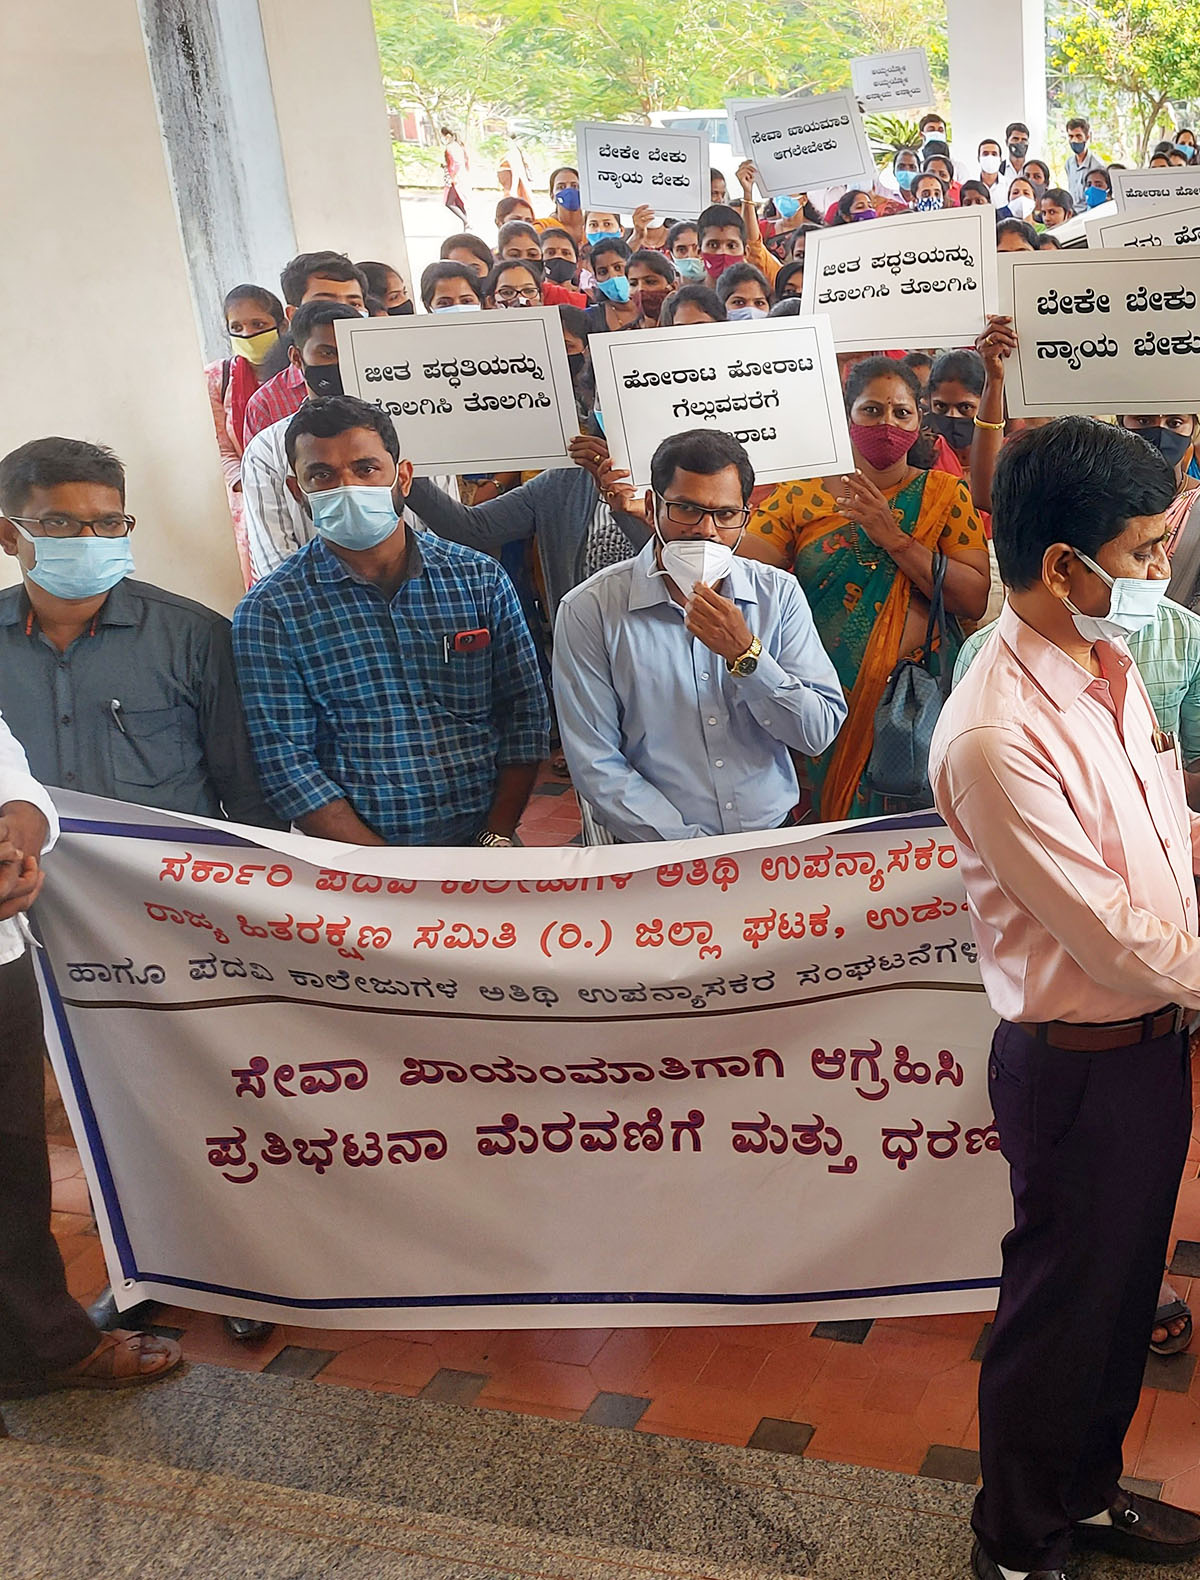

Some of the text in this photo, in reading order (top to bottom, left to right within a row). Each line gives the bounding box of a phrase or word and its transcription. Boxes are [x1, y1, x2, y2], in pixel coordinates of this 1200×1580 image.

[599, 143, 687, 163] ಬೇಕೇ ಬೇಕು
[751, 129, 782, 145] ಸೇವಾ
[598, 169, 691, 189] ನ್ಯಾಯ ಬೇಕು
[1125, 188, 1171, 198] ಹೋರಾಟ
[823, 244, 975, 277] ಜೀತ ಪದ್ಧತಿಯನ್ನು
[818, 276, 978, 304] ತೊಲಗಿಸಿ ತೊಲಗಿಸಿ
[1036, 284, 1197, 315] ಬೇಕೇ ಬೇಕು
[1036, 333, 1119, 370] ನ್ಯಾಯ
[364, 352, 545, 389] ಜೀತ ಪದ್ಧತಿಯನ್ನು
[623, 357, 814, 389] ಹೋರಾಟ ಹೋರಾಟ
[463, 391, 551, 412] ತೊಲಗಿಸಿ
[672, 389, 780, 421] ಗೆಲ್ಲುವವರೆಗೆ
[727, 425, 777, 444] ರಾಟ
[158, 852, 294, 888] ಸರ್ಕಾರಿ
[655, 857, 740, 893] ಅತಿಥಿ
[761, 838, 959, 893] ಉಪನ್ಯಾಸಕರ
[143, 901, 231, 945] ರಾಜ್ಯ
[412, 917, 518, 950] ಸಮಿತಿ
[539, 919, 614, 958] (ರಿ.)
[634, 917, 723, 960] ಜಿಲ್ಲಾ
[742, 904, 846, 949] ಘಟಕ,
[866, 896, 969, 931] ಉಡು
[66, 957, 167, 985] ಹಾಗೂ
[188, 952, 275, 982] ಪದವಿ
[288, 969, 458, 999] ಕಾಲೇಜುಗಳ
[478, 983, 560, 1008] ಅತಿಥಿ
[577, 970, 776, 1009] ಉಪನ್ಯಾಸಕರ
[231, 1038, 964, 1101] ಸೇವಾ ಖಾಯಂಮಾತಿಗಾಗಿ ಆಗ್ರಹಿಸಿ
[205, 1107, 1001, 1184] ಪ್ರತಿಭಟನಾ ಮೆರವಣಿಗೆ ಮತ್ತು ಧರಣ
